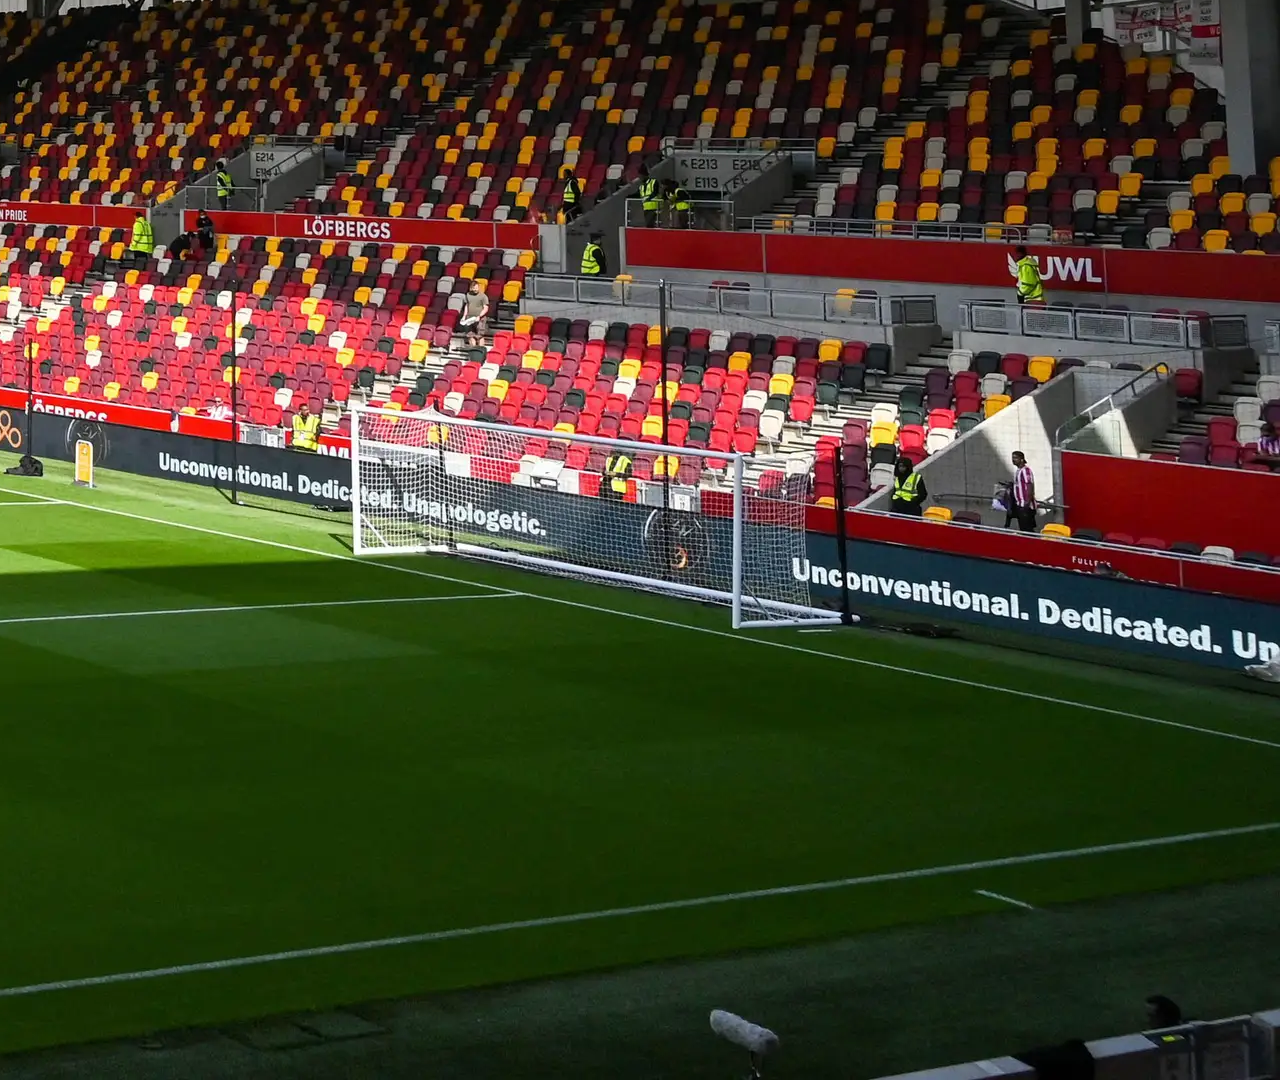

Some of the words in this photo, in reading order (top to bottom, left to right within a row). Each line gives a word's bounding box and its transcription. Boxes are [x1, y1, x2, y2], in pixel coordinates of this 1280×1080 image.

[256, 152, 274, 162] E214
[691, 158, 718, 169] E213
[695, 177, 718, 188] E113
[5, 209, 28, 221] PRIDE
[303, 215, 391, 239] LÖFBERGS
[298, 474, 398, 510] Dedicted.
[792, 557, 1030, 621] Unconventional.
[1037, 597, 1223, 654] Dedicated.
